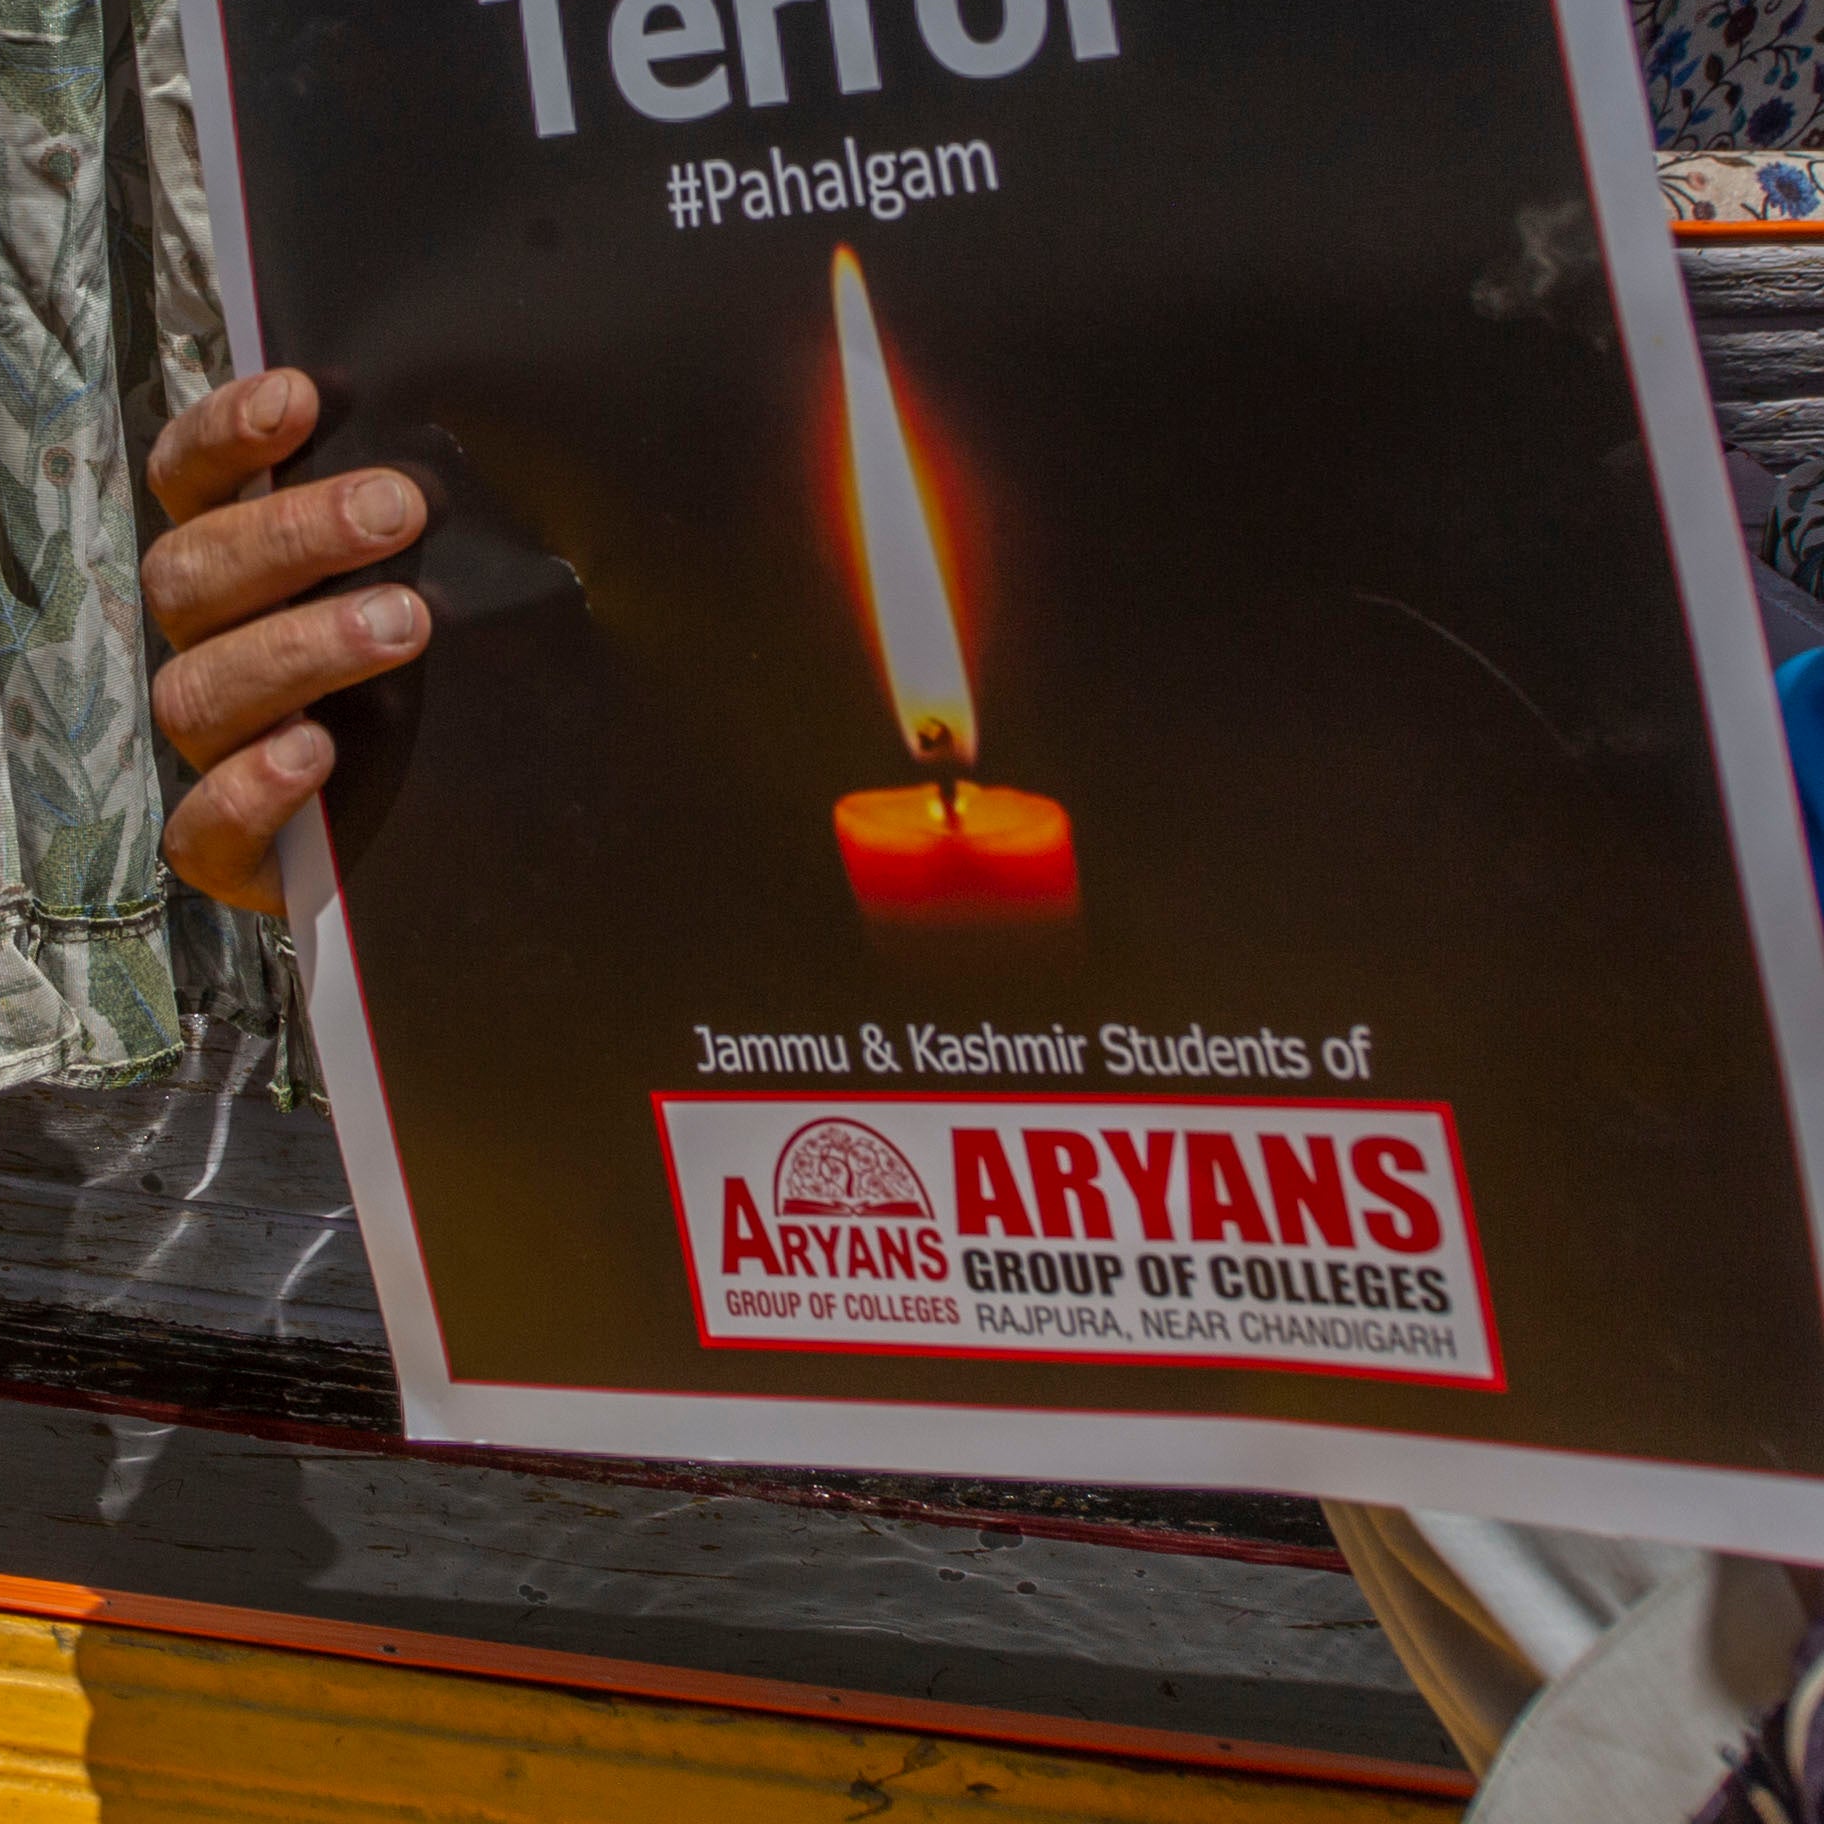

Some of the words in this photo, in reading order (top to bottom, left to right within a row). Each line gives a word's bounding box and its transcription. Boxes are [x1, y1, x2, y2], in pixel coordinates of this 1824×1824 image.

[665, 135, 1000, 229] #Pahalgam
[693, 1024, 850, 1076] Jammu
[860, 1023, 903, 1074] &
[910, 1023, 1089, 1076] Kashmir
[1100, 1024, 1312, 1080] Students
[1321, 1025, 1372, 1081] of
[951, 1126, 1443, 1256] ARYANS
[720, 1176, 949, 1284] ARYANS
[725, 1288, 805, 1320] GROUP
[809, 1290, 837, 1321] OF
[842, 1292, 960, 1326] COLLEGES
[963, 1248, 1124, 1299] GROUP
[1140, 1254, 1198, 1301] OF
[1209, 1258, 1451, 1314] COLLEGES
[976, 1302, 1133, 1343] RAJPURA,
[1140, 1307, 1232, 1344] NEAR
[1239, 1309, 1459, 1359] CHANDIGARH
